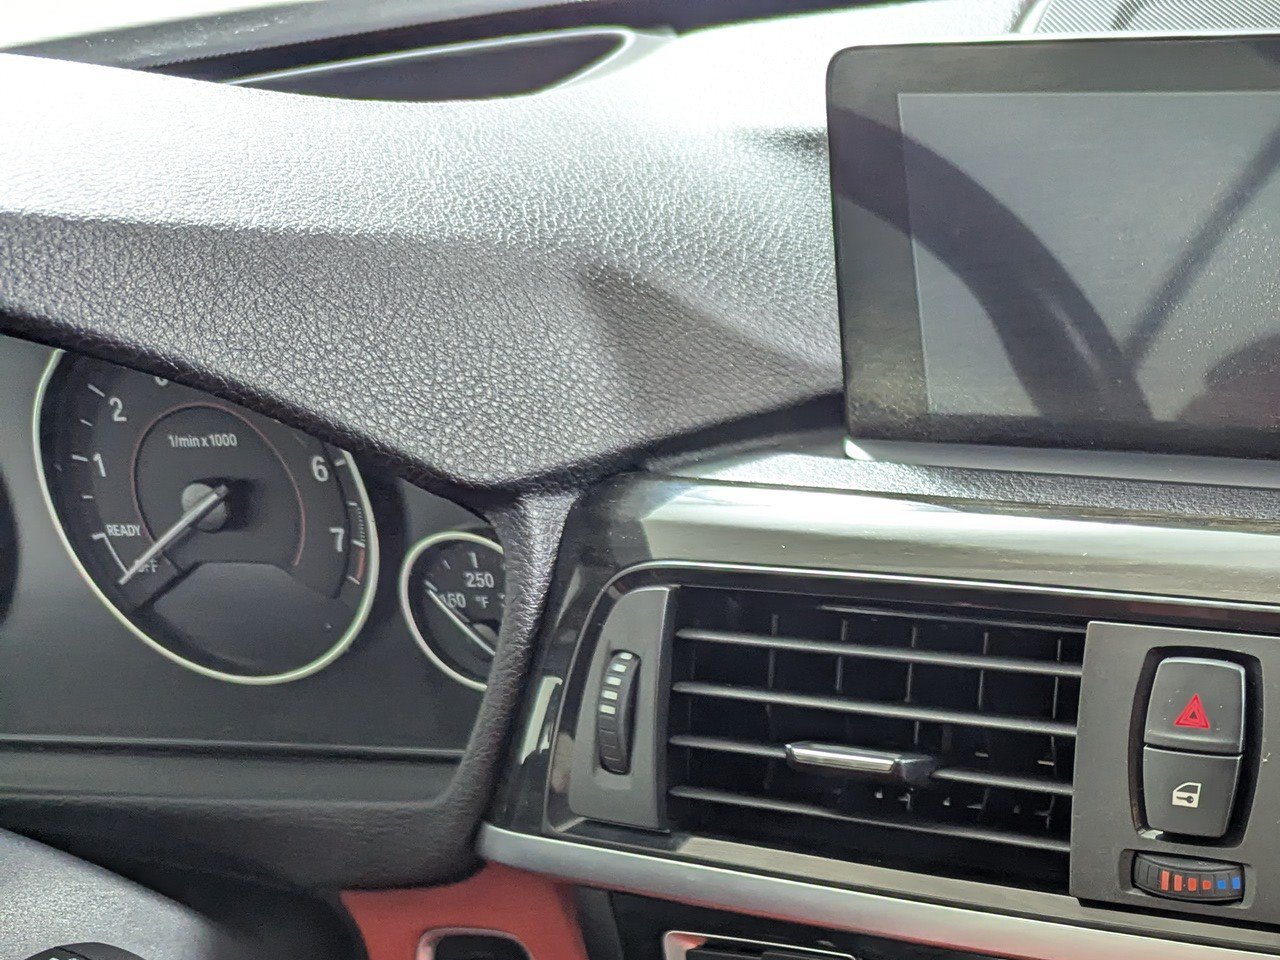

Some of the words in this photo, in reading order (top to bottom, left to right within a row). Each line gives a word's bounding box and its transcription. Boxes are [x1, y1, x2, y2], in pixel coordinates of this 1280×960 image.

[109, 397, 127, 422] 2
[168, 434, 200, 448] 1/min
[209, 433, 238, 447] 1000
[93, 453, 106, 477] 1
[311, 454, 329, 482] 6
[105, 524, 141, 537] READY
[329, 527, 345, 552] 7
[464, 571, 495, 588] 250
